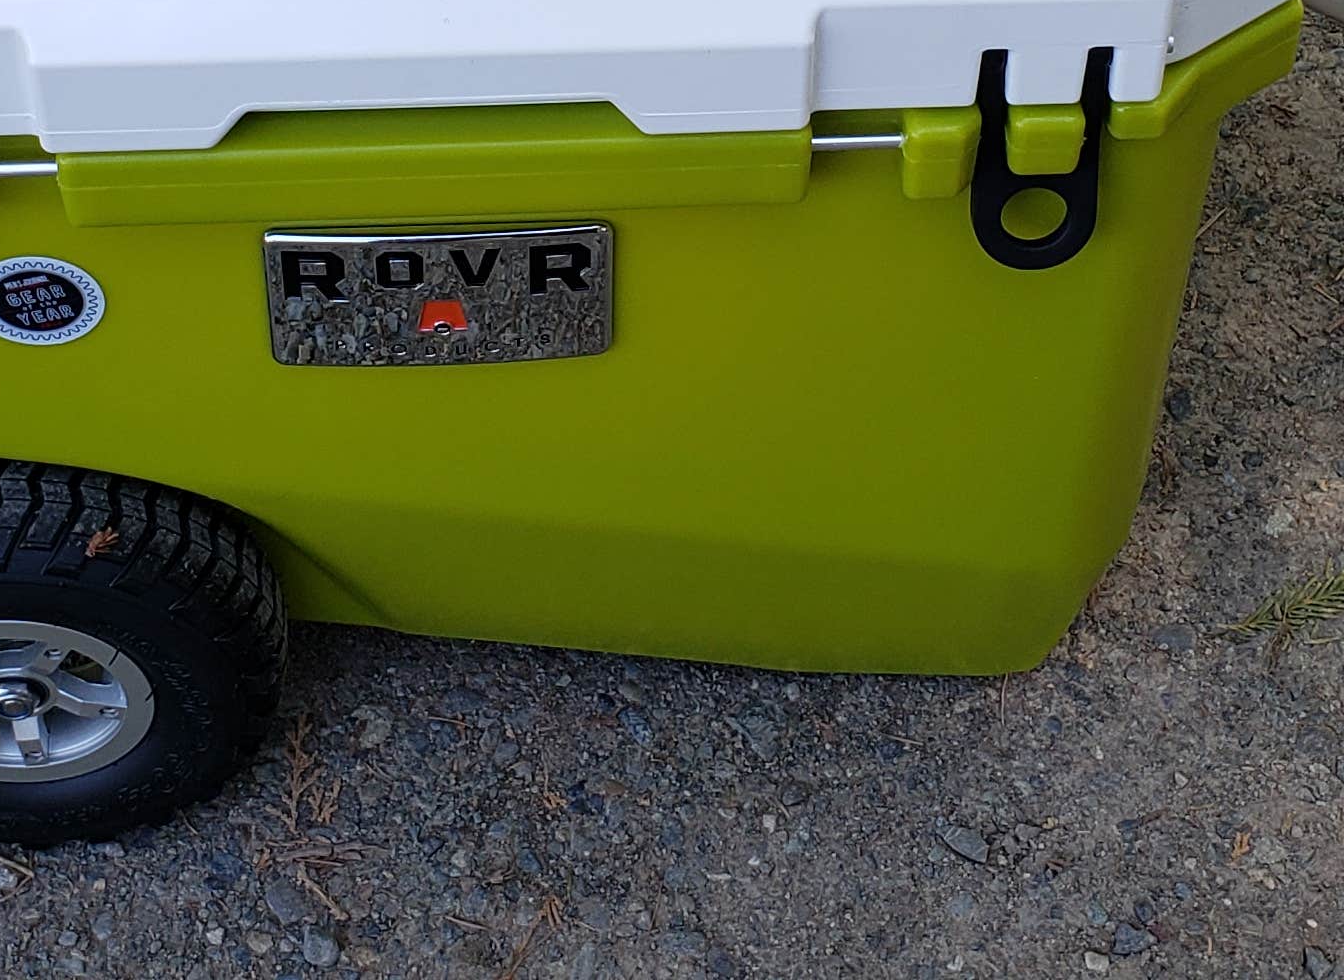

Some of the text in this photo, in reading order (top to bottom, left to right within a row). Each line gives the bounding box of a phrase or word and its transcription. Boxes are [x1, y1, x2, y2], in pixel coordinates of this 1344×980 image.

[280, 243, 593, 303] ROVR
[5, 284, 66, 307] GEAR
[16, 304, 75, 326] YEAR
[335, 333, 552, 358] PRODUCTS
